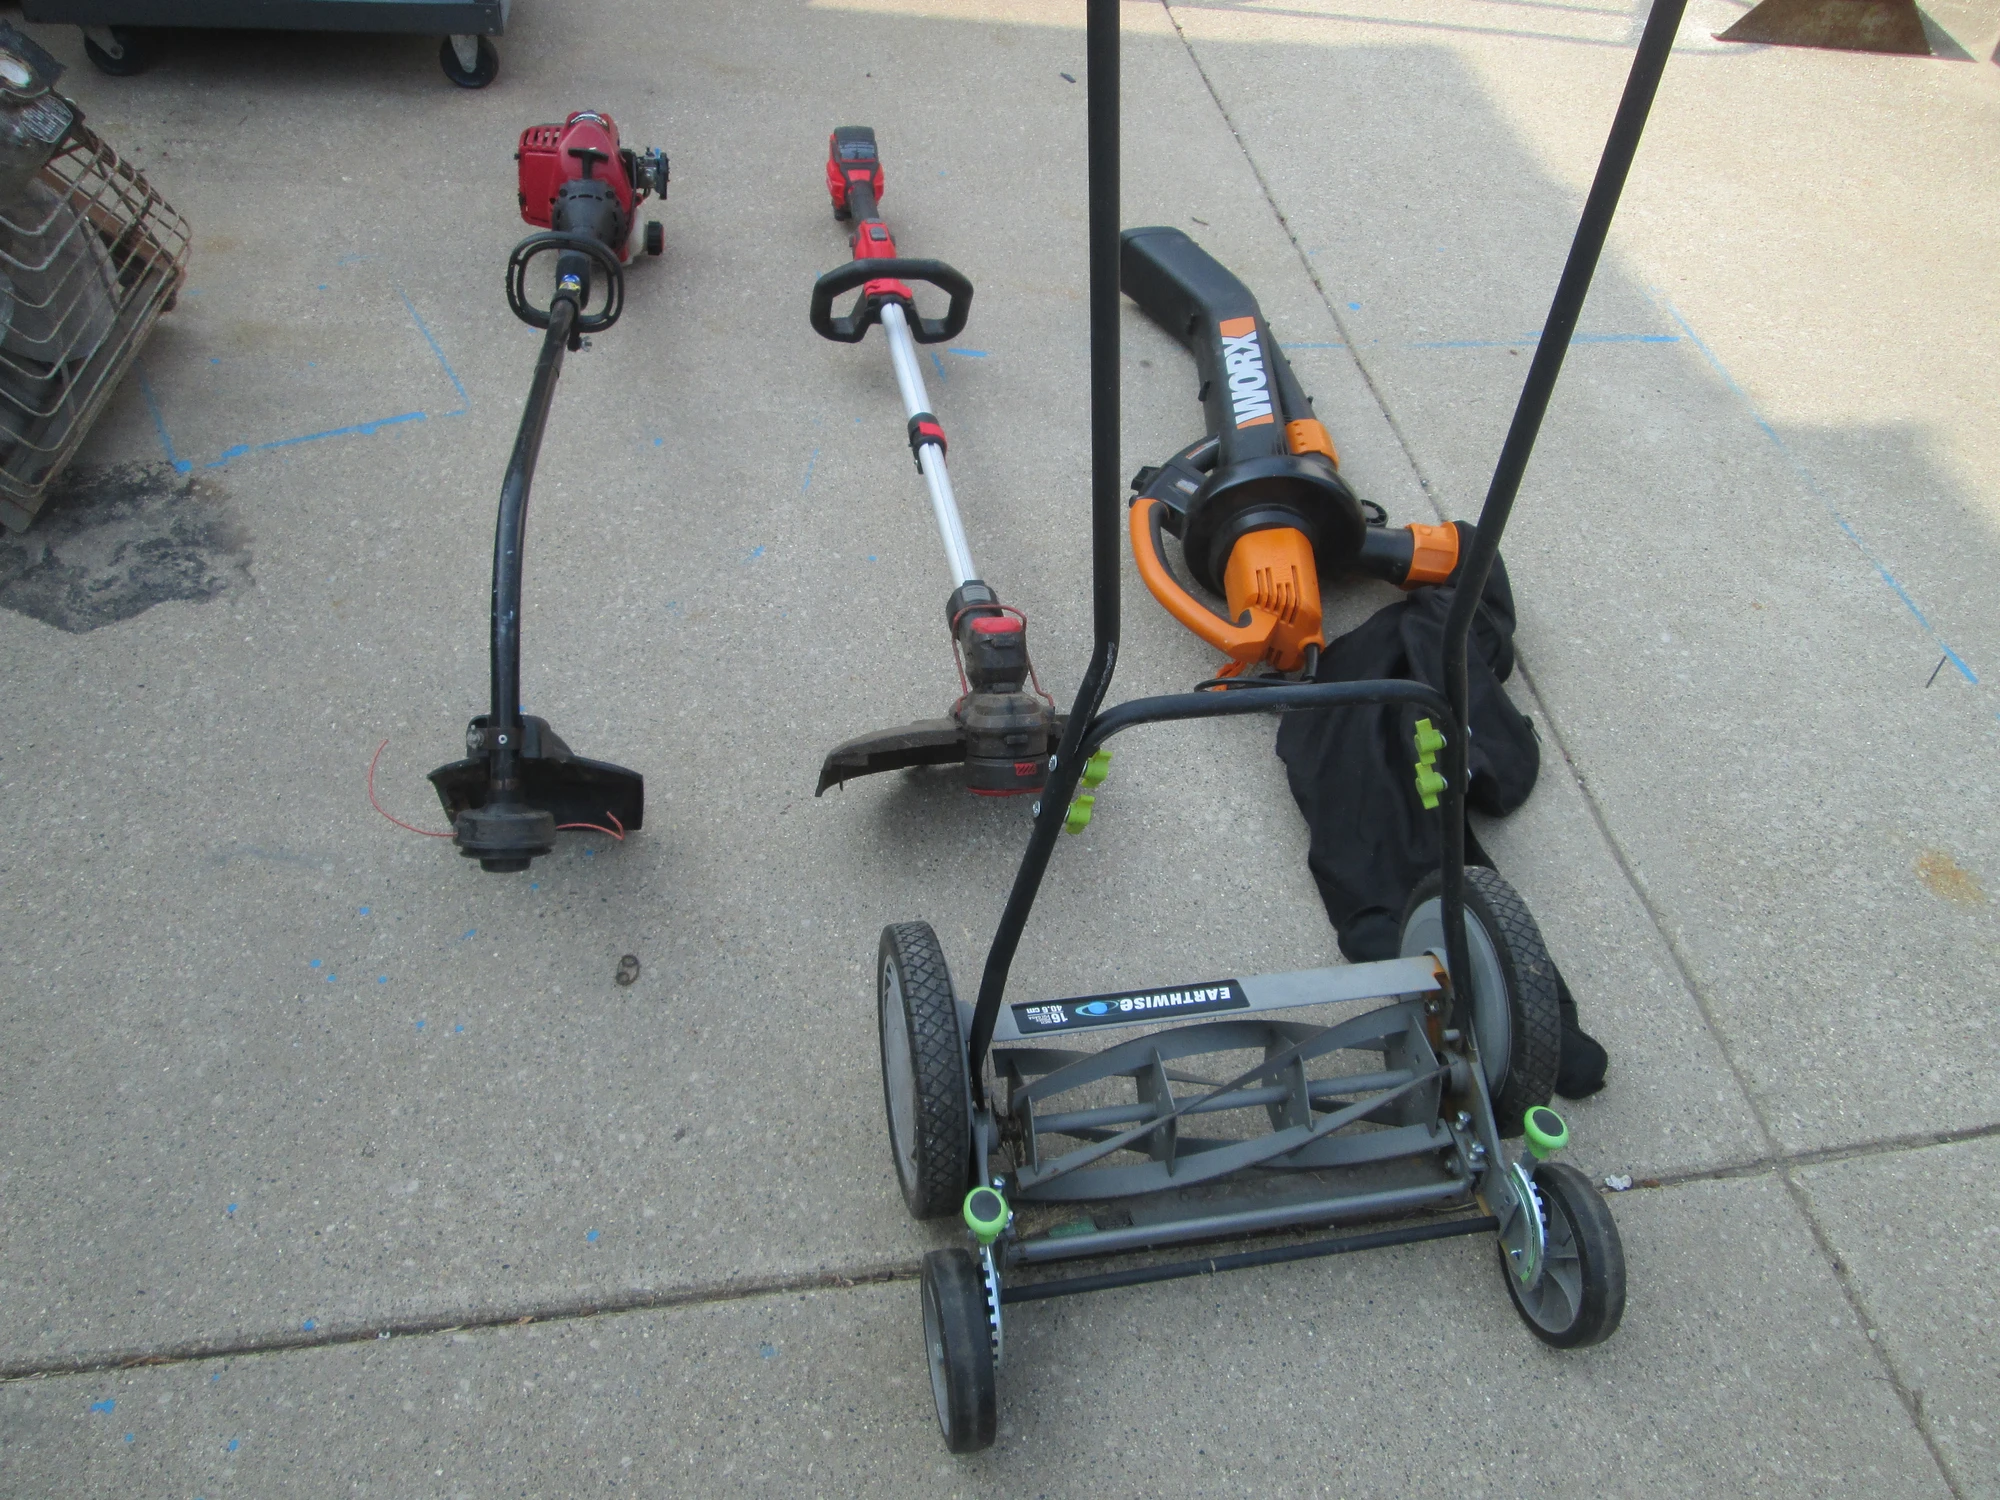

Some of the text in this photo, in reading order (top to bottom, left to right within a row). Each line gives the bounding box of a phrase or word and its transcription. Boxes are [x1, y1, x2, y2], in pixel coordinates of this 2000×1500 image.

[1221, 331, 1272, 424] WORX
[1041, 1005, 1062, 1014] 40.6
[1051, 1012, 1068, 1023] 16
